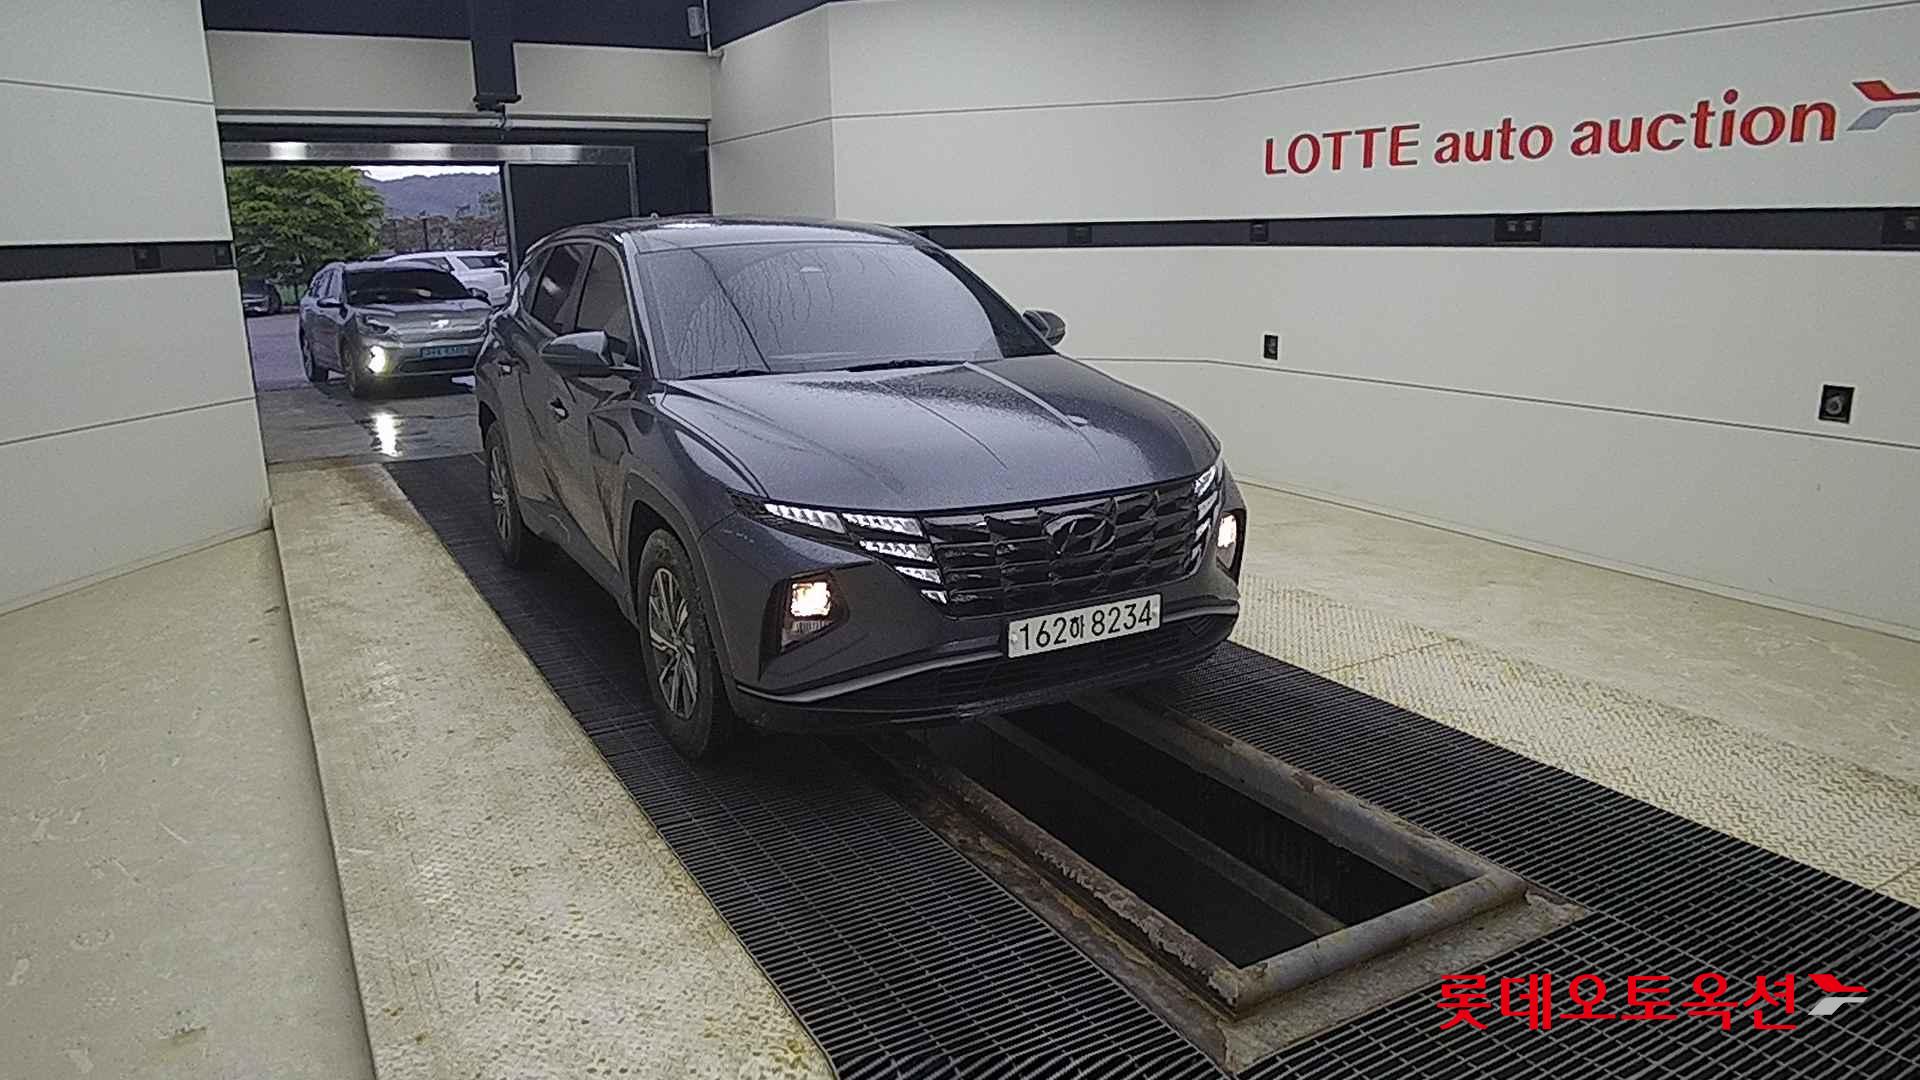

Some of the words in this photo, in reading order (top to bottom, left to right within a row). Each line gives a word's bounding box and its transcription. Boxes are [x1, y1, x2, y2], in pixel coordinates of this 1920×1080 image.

[1265, 123, 1421, 176] LOTTE
[1434, 117, 1553, 165] auto
[1569, 89, 1837, 157] auction
